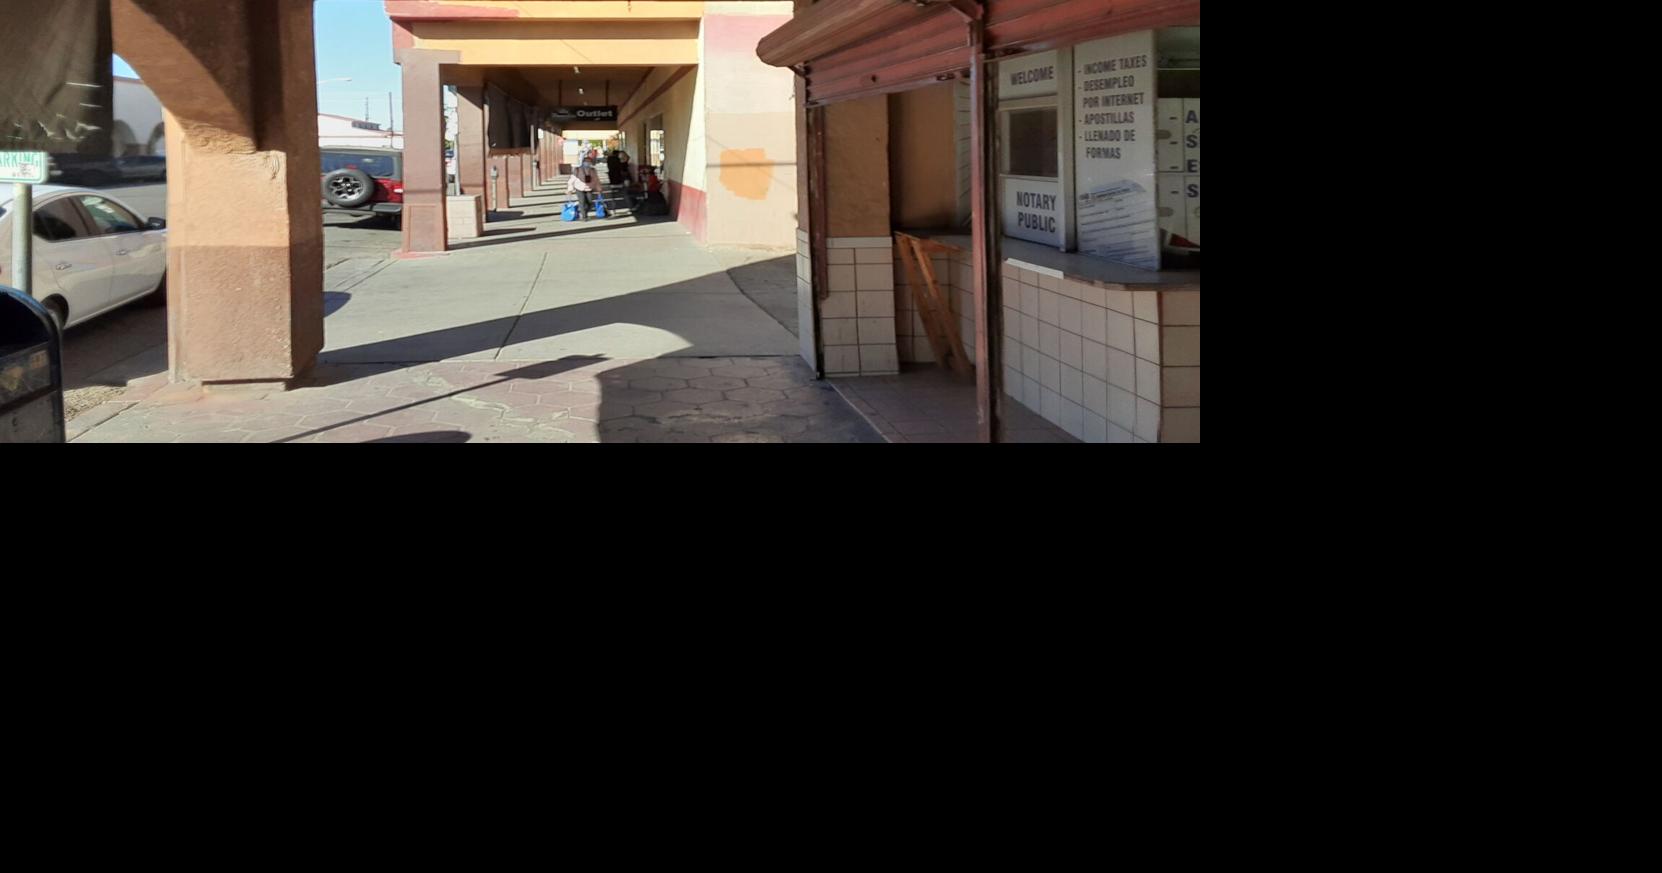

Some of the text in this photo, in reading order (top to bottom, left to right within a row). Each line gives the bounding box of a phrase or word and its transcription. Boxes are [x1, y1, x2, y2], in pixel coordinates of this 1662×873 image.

[1083, 54, 1148, 75] INCOME TAXES
[1010, 65, 1055, 86] WELCOME
[1083, 75, 1135, 92] DESEMPLEO
[1083, 92, 1145, 109] POR INTERNET
[1083, 111, 1135, 126] APOSTILLAS
[1084, 129, 1136, 142] LLENADO DE
[1086, 147, 1121, 160] FORMAS
[1016, 190, 1057, 211] NOTARY
[1017, 212, 1056, 234] PUBLIC
